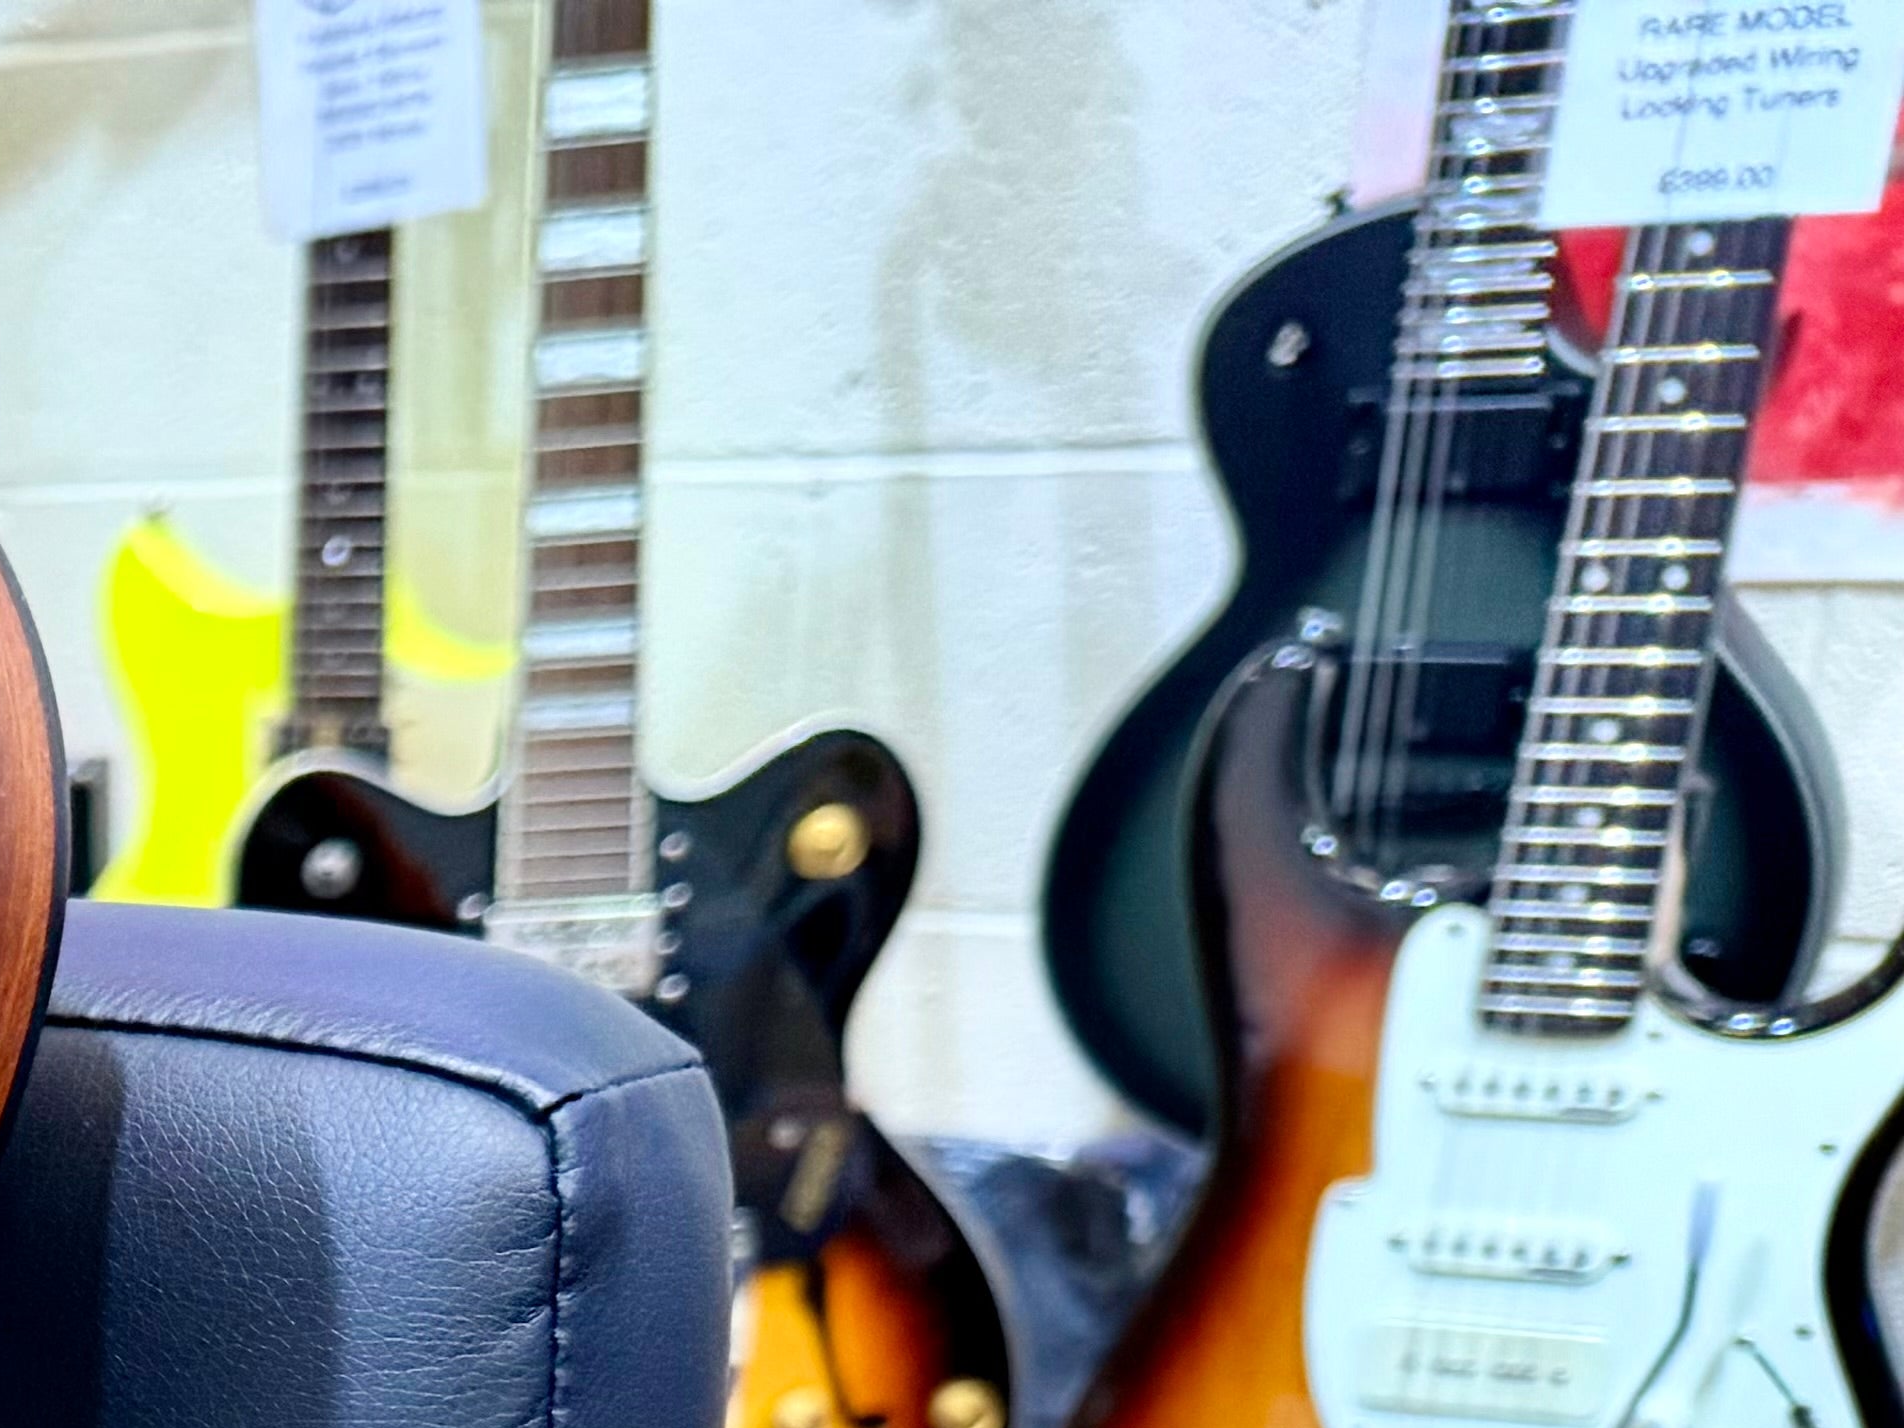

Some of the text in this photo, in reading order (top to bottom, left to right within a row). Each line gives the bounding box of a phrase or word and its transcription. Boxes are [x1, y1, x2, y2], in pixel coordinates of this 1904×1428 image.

[1639, 3, 1852, 39] RARE MODEL
[1618, 46, 1861, 85] Upgraded Wiring
[1620, 86, 1840, 121] Locking Tuners
